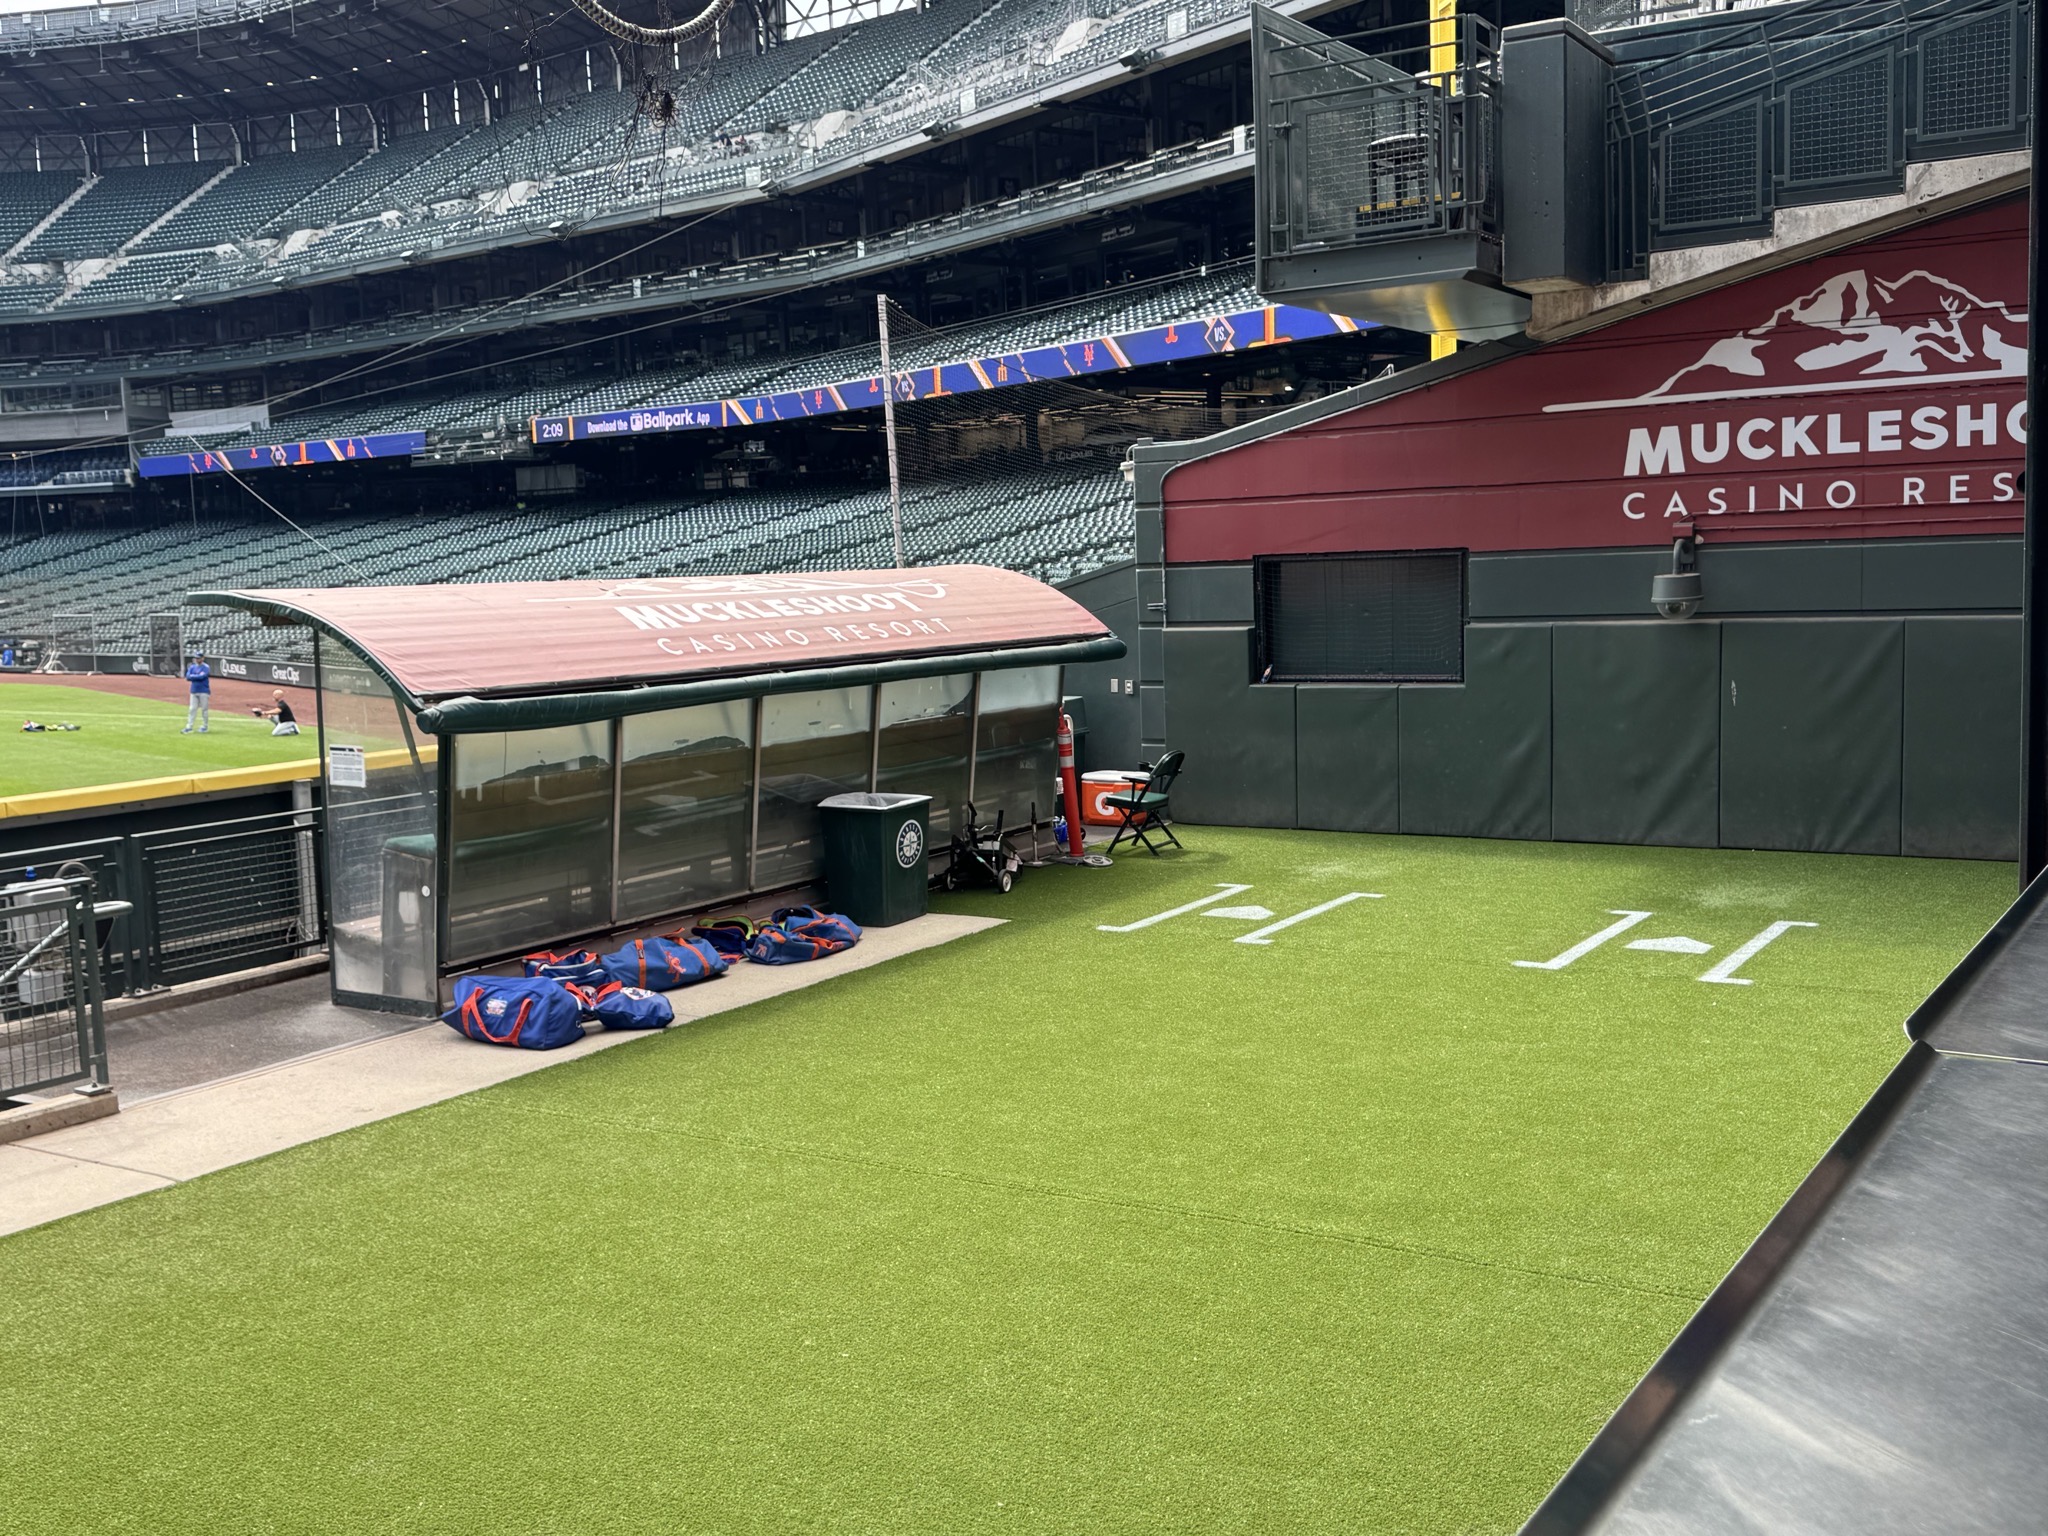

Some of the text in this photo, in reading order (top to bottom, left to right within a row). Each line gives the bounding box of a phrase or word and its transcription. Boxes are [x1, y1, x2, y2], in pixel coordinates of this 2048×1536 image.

[542, 423, 563, 438] 2:09
[587, 408, 711, 434] Download the Ballpark App
[1622, 480, 1857, 520] CASINO
[614, 591, 923, 631] MUCKLESHOOT
[656, 617, 953, 656] CASINO RESORT
[226, 663, 247, 675] LEXUS
[271, 664, 300, 685] Great Clips
